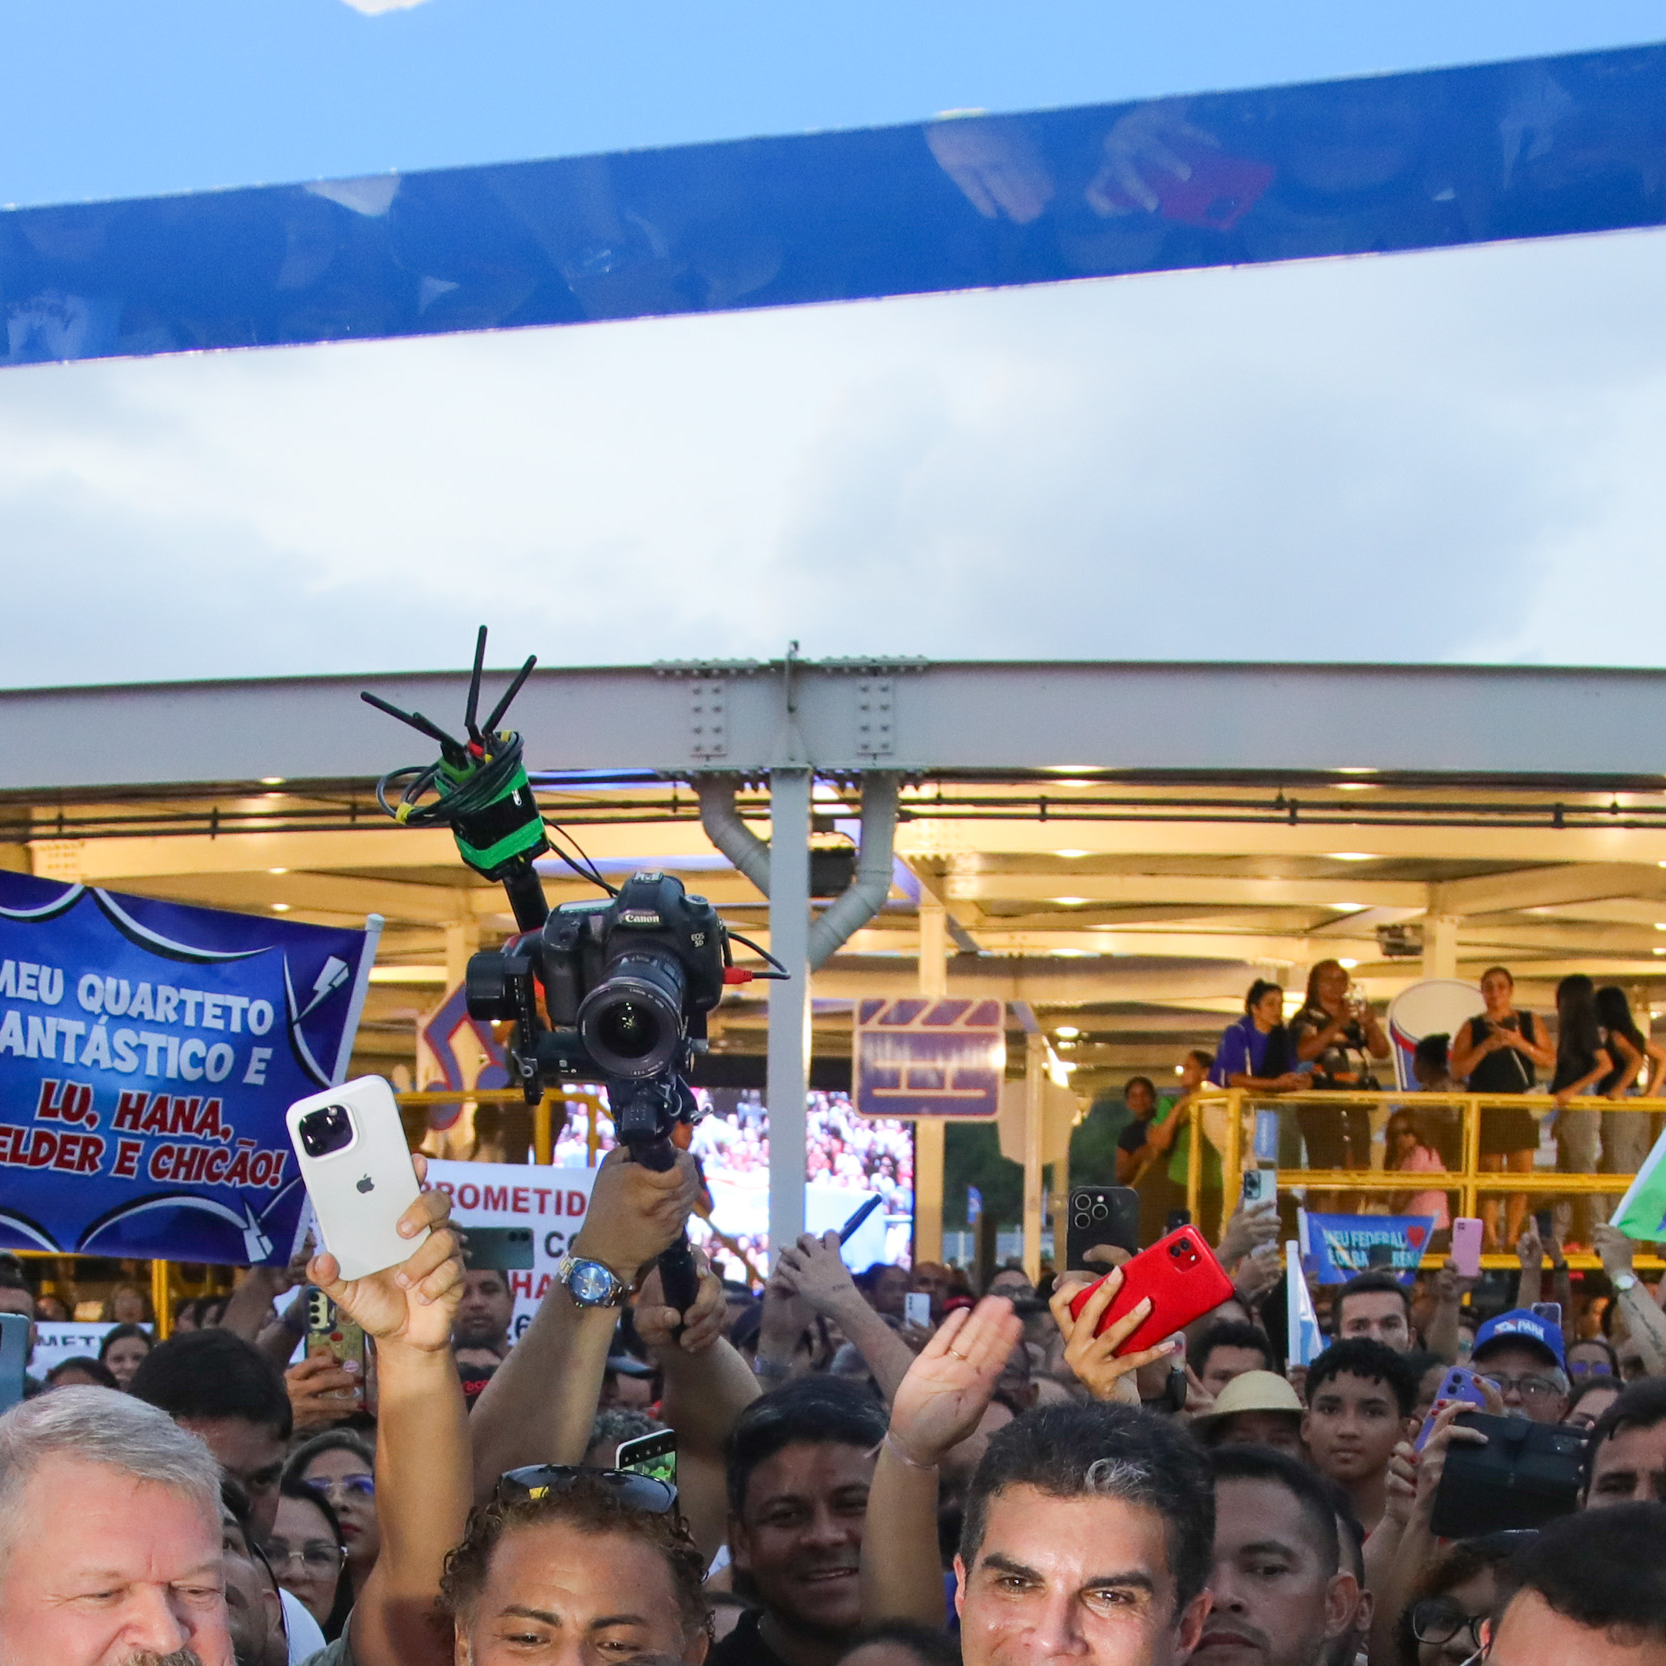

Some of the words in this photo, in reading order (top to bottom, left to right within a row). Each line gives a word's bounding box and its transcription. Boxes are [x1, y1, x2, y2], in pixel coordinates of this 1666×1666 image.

[624, 914, 660, 924] Canon
[690, 932, 706, 942] EOS
[77, 974, 274, 1036] QUARTETO
[242, 1046, 273, 1085] E
[35, 1078, 100, 1130] LU,
[110, 1088, 233, 1143] HANA,
[109, 1137, 145, 1178] E
[148, 1138, 288, 1190] CHICÃO!
